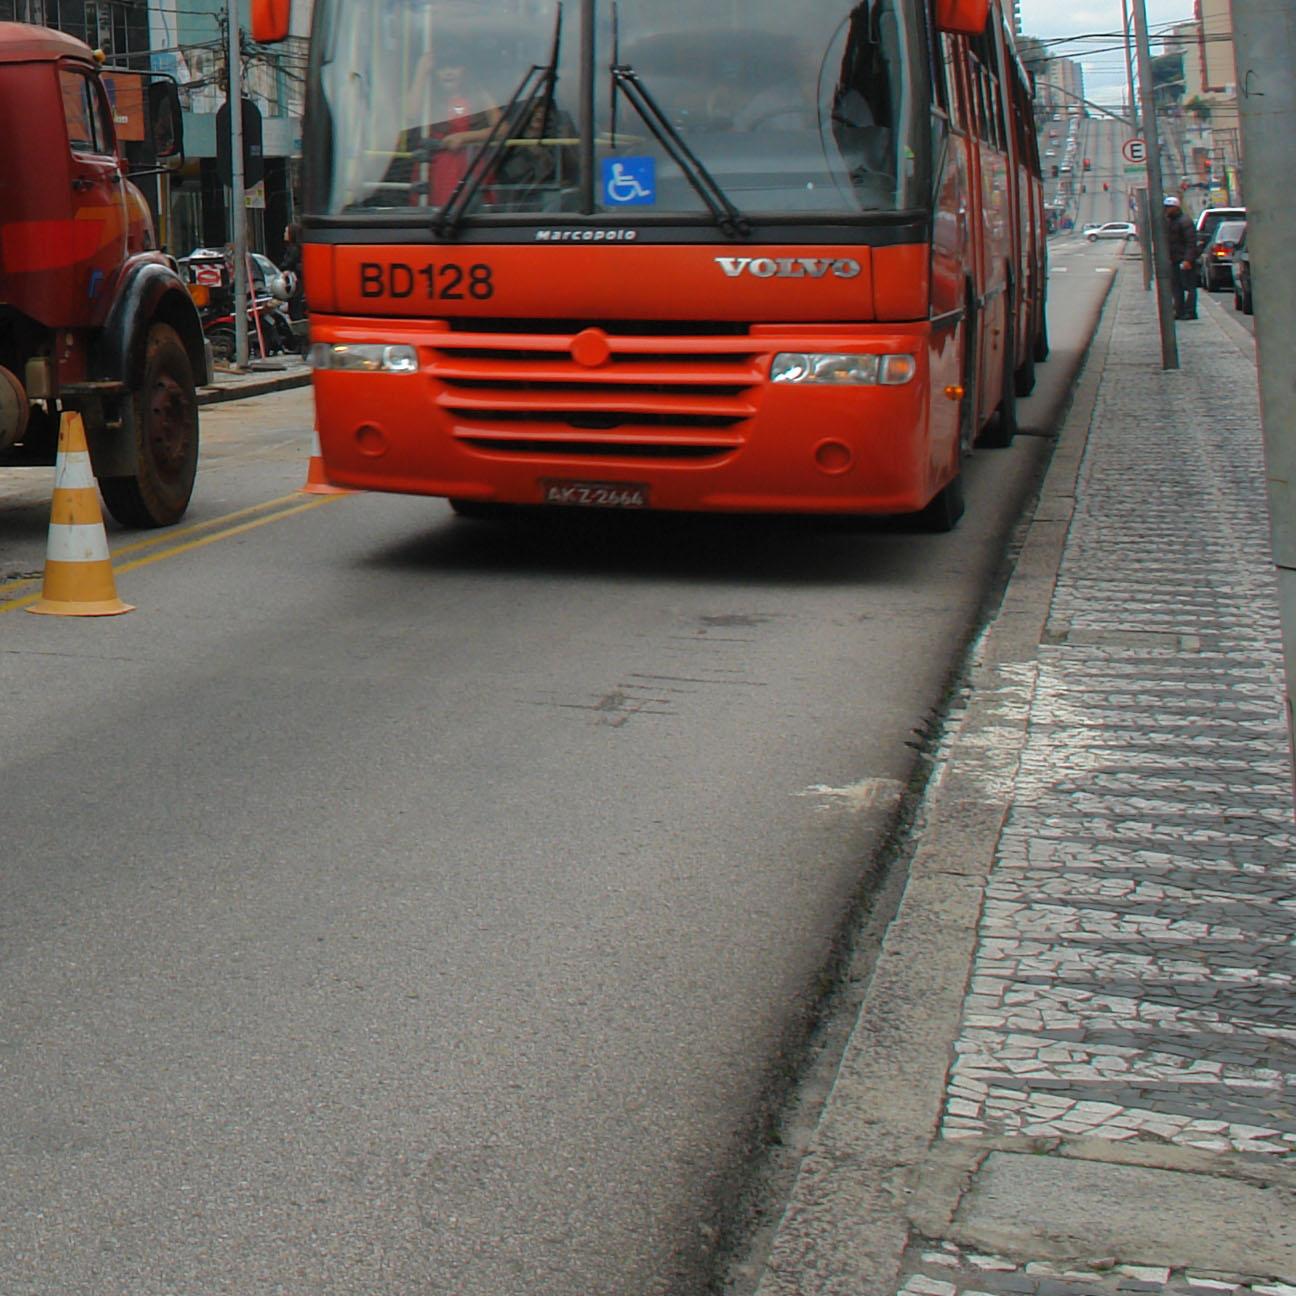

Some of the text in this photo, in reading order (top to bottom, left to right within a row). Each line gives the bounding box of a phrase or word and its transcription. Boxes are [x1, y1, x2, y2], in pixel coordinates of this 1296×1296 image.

[1130, 143, 1143, 159] E
[535, 229, 637, 241] Marcopolo
[714, 256, 862, 279] VOLVO
[359, 262, 494, 301] BD128
